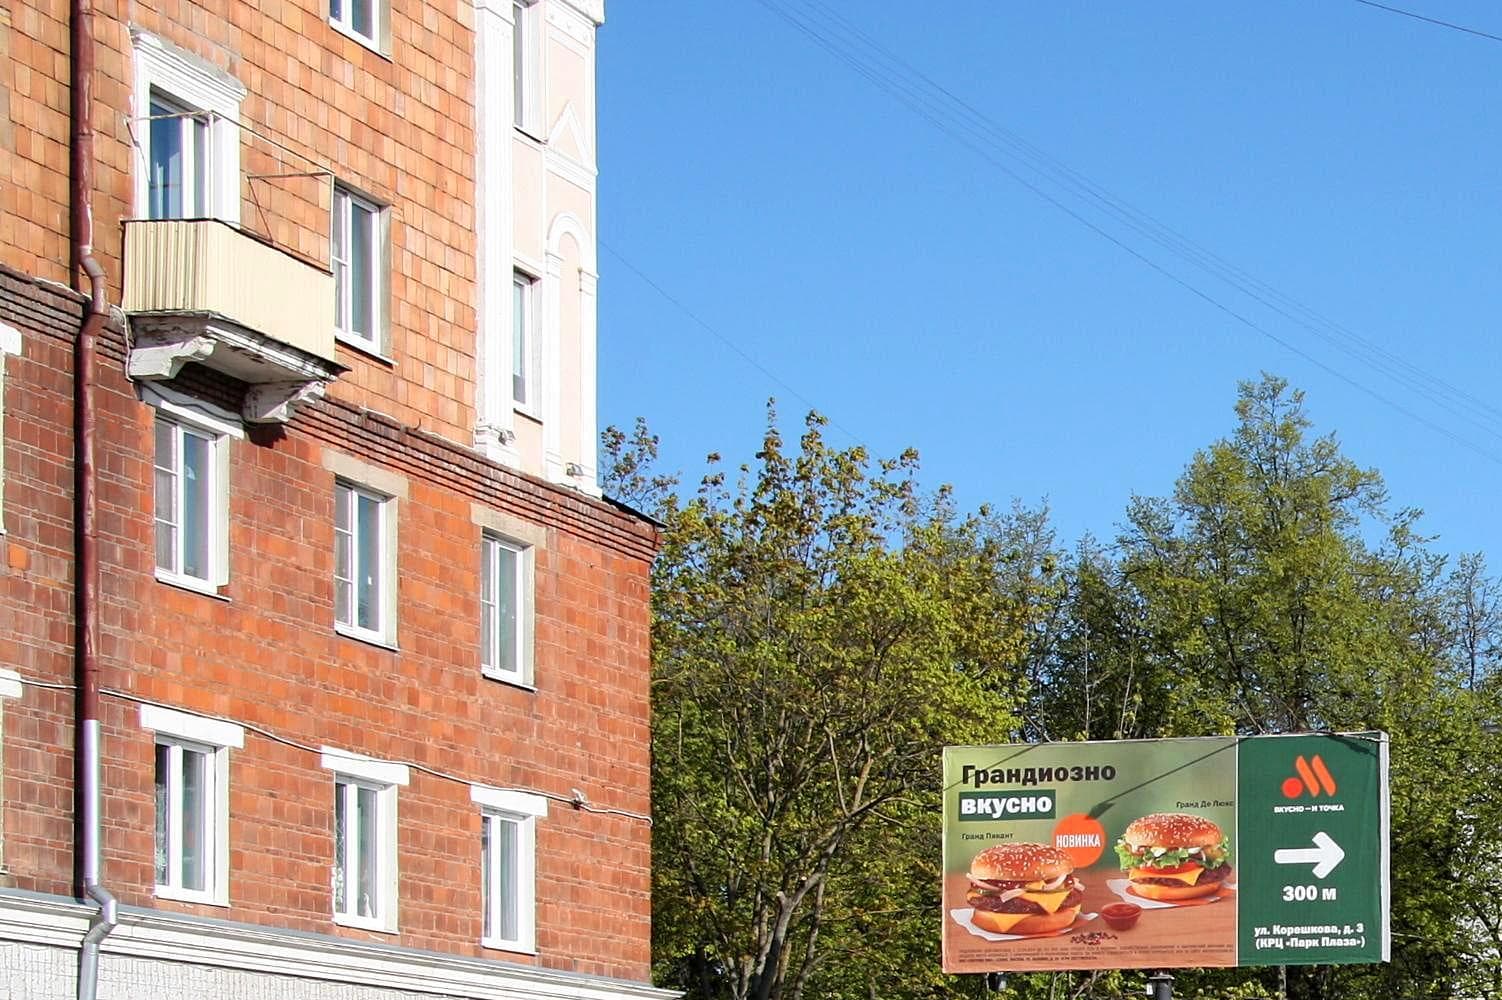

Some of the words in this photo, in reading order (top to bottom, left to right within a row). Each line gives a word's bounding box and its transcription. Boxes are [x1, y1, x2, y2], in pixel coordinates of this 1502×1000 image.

[962, 765, 1116, 788] Грандиозно
[960, 796, 1053, 819] вкусно
[1056, 834, 1101, 848] НОВИНКА
[1282, 885, 1318, 901] 300
[1322, 888, 1337, 900] м
[1254, 927, 1270, 937] ул.
[1272, 925, 1341, 936] Корешкова,
[1343, 924, 1354, 935] д.
[1356, 923, 1364, 933] 3
[1255, 938, 1284, 949] (КРЦ
